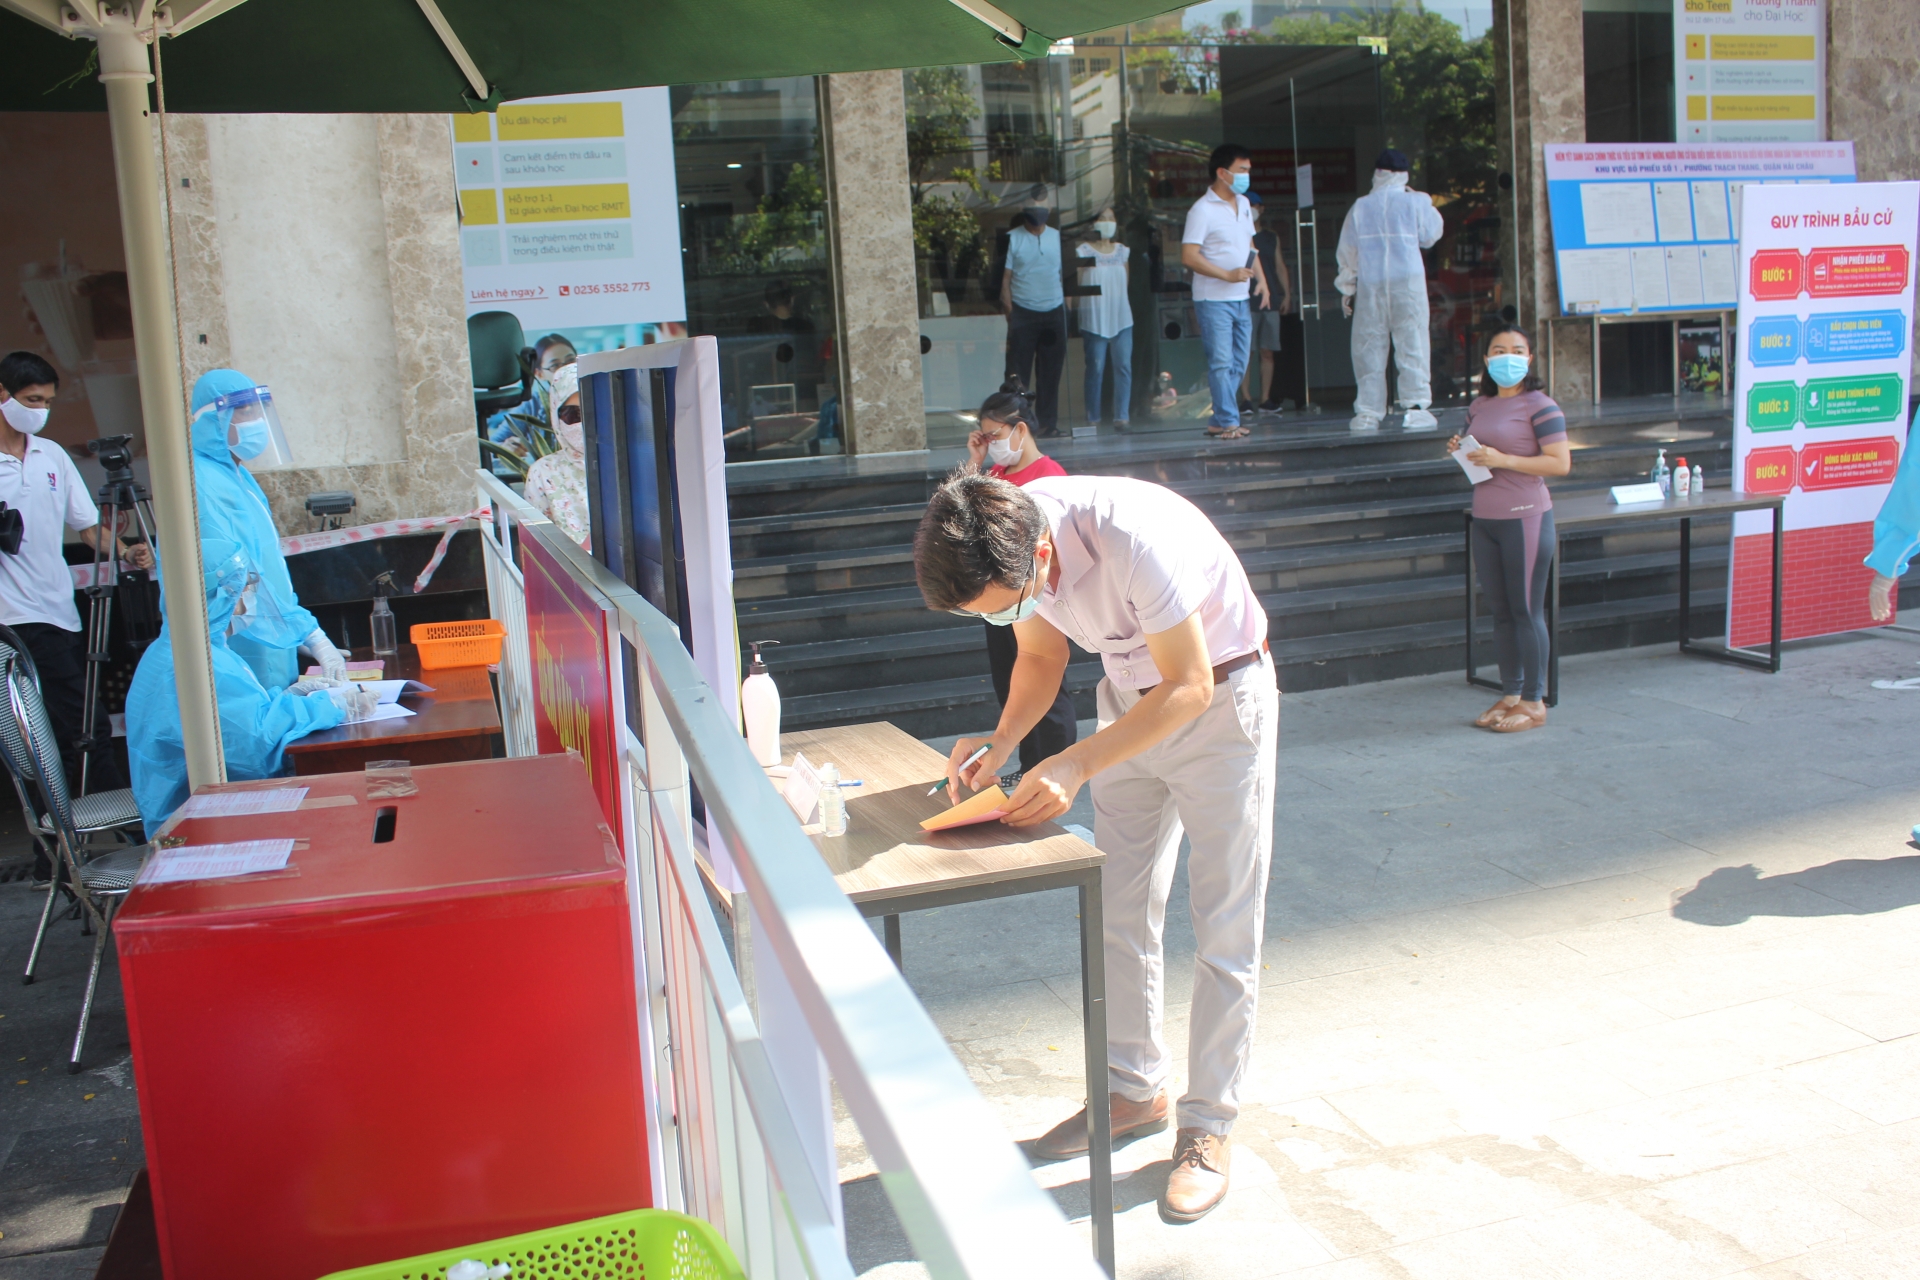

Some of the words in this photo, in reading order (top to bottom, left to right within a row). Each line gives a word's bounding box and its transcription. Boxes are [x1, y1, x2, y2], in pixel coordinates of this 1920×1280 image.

[1706, 0, 1730, 10] Teen
[1744, 10, 1762, 20] cho
[1765, 10, 1781, 22] Đại
[1784, 10, 1804, 22] Học
[501, 116, 514, 125] Ưu
[516, 115, 530, 125] đãi
[533, 116, 550, 125] học
[552, 115, 567, 125] phí
[504, 153, 526, 162] Cam
[528, 152, 542, 161] kết
[544, 151, 567, 160] điểm
[569, 151, 582, 160] thi
[583, 150, 600, 159] đầu
[505, 166, 521, 174] sau
[523, 164, 545, 173] khóa
[548, 164, 565, 174] học
[508, 194, 522, 203] Hỗ
[524, 195, 538, 203] trợ
[540, 194, 553, 202] 1-1
[509, 207, 519, 215] từ
[521, 207, 541, 216] giáo
[543, 205, 562, 214] viên
[565, 204, 580, 213] Đại
[582, 203, 599, 213] học
[601, 202, 624, 211] RMIT
[1771, 215, 1799, 229] QUY
[1803, 210, 1840, 228] TRÌNH
[1874, 207, 1893, 226] CỬ
[512, 234, 530, 244] Trải
[532, 233, 567, 245] nghiệm
[569, 232, 588, 241] một
[589, 231, 601, 240] thi
[604, 230, 619, 239] thử
[513, 247, 538, 256] trong
[540, 245, 560, 254] điều
[562, 244, 582, 253] kiện
[583, 243, 595, 252] thi
[597, 242, 615, 251] thật
[1762, 267, 1785, 282] BƯỚC
[1788, 269, 1792, 281] 1
[471, 289, 493, 299] Liên
[496, 288, 508, 298] hệ
[511, 288, 536, 299] ngay
[574, 284, 600, 295] 0236
[602, 283, 629, 293] 3552
[632, 281, 650, 292] 773
[1760, 333, 1783, 349] BƯỚC
[1785, 334, 1791, 347] 2
[1758, 398, 1781, 414] BƯỚC
[1783, 400, 1789, 413] 3
[1756, 464, 1779, 479] BƯỚC
[1780, 465, 1786, 477] 4
